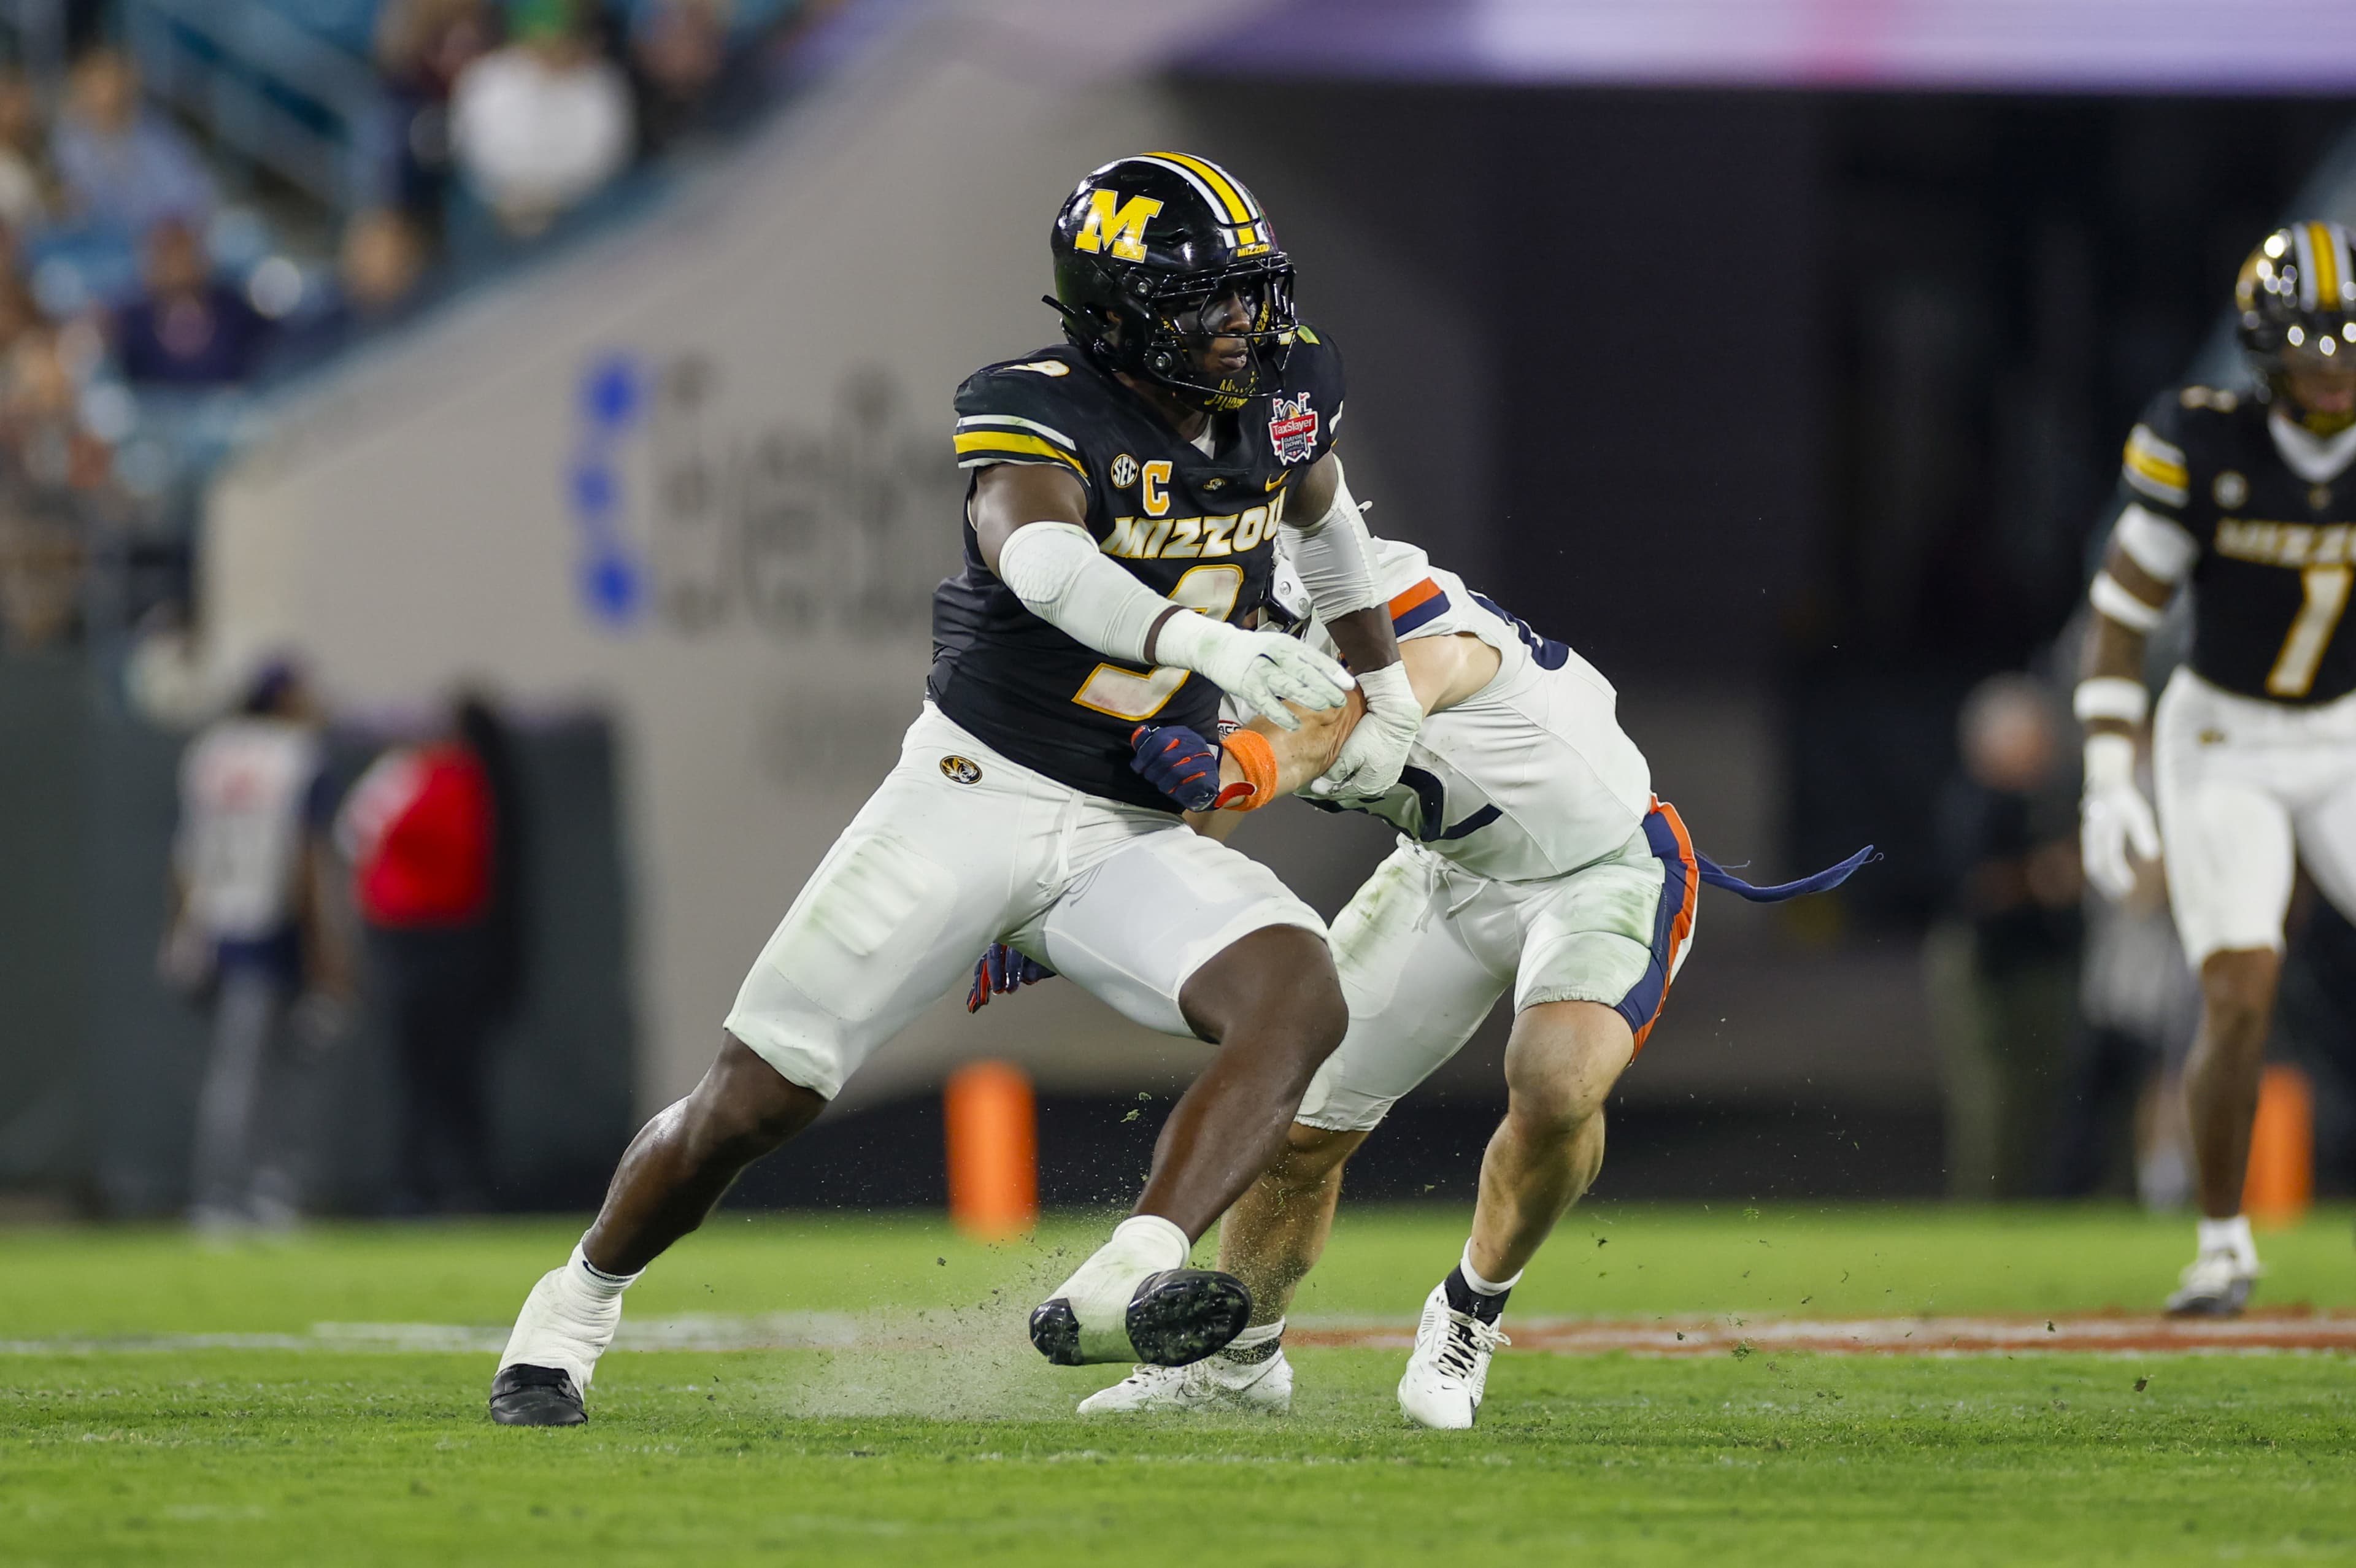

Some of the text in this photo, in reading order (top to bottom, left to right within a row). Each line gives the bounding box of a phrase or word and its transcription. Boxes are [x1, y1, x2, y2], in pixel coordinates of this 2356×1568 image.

[1074, 188, 1165, 264] M
[1272, 418, 1313, 435] TaxSlayer
[1285, 440, 1304, 449] BOWL
[1113, 456, 1137, 486] SEC
[1142, 459, 1173, 517] C
[1099, 486, 1287, 559] MIZZOU
